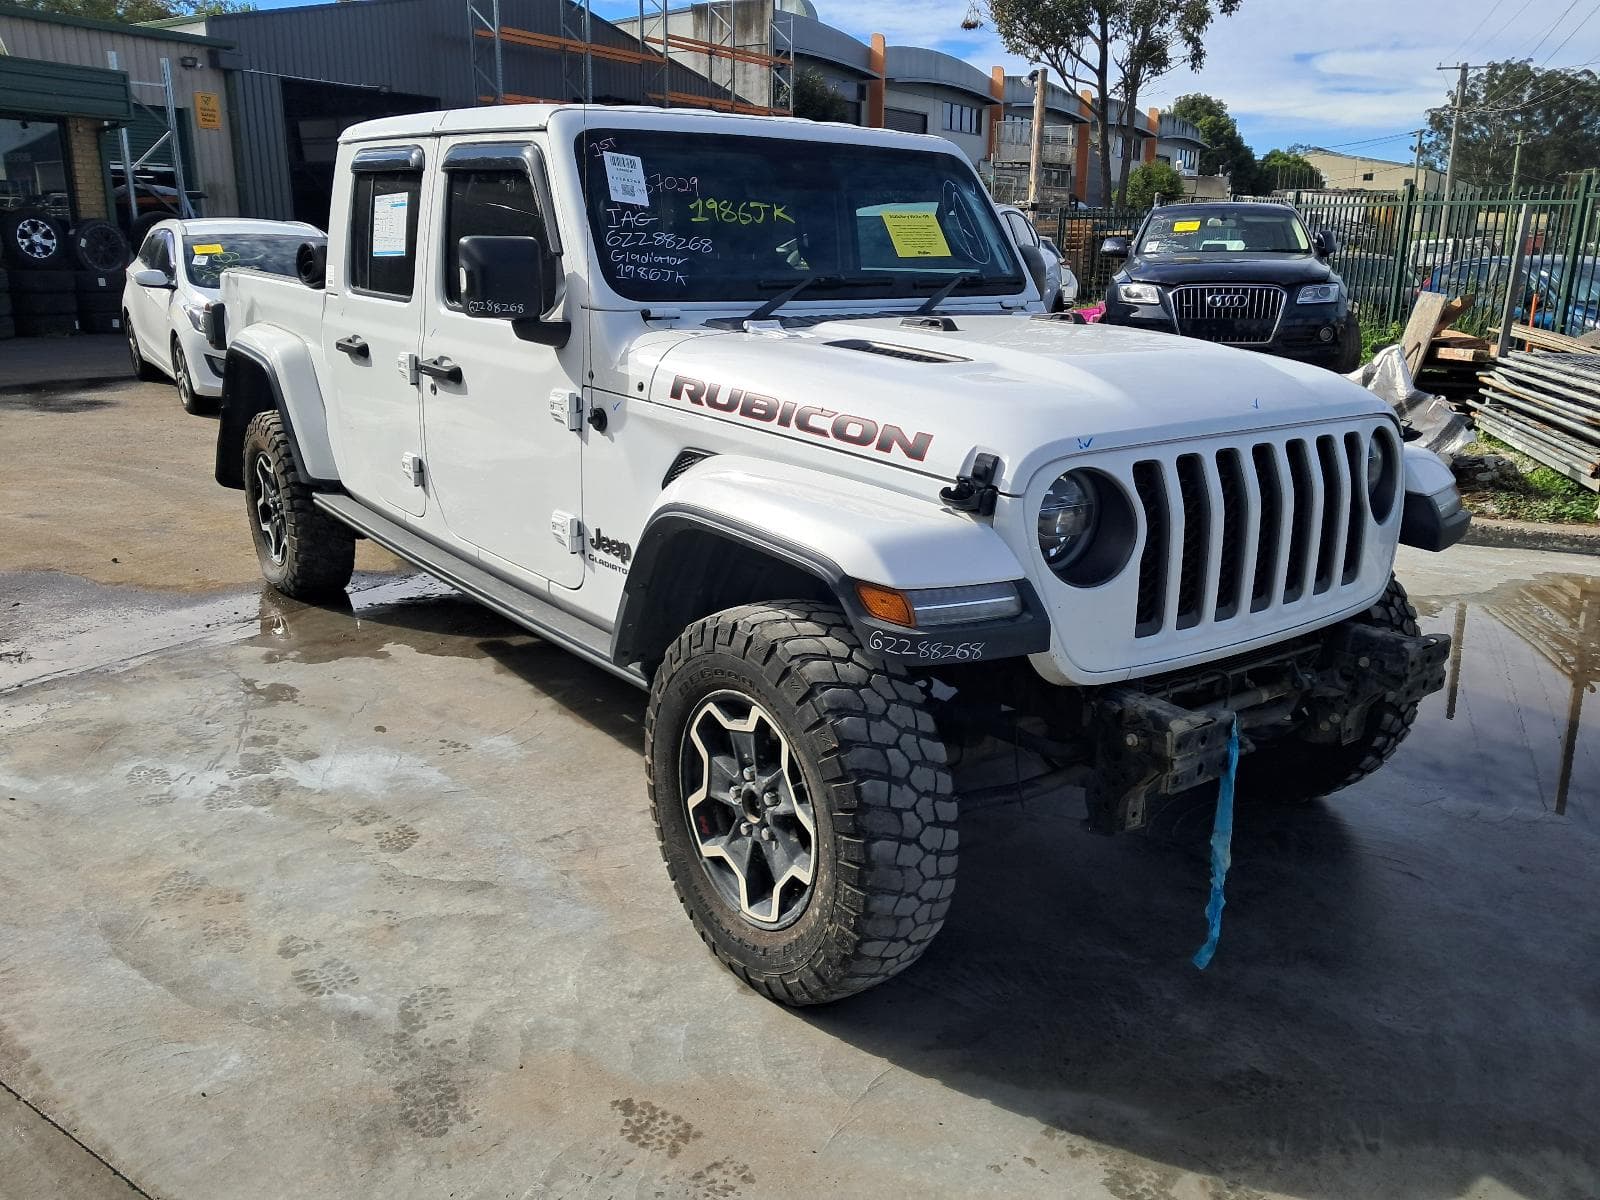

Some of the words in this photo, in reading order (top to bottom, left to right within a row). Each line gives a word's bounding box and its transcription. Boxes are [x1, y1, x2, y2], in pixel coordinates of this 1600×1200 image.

[590, 138, 616, 157] 1ST
[645, 174, 699, 197] 7029
[606, 208, 659, 228] IAG
[688, 197, 796, 225] 1986JK
[606, 230, 713, 253] 62288268
[616, 264, 688, 287] 1986JK
[468, 299, 525, 314] 62288268
[669, 374, 935, 462] RUBICON
[589, 527, 632, 565] Jeep
[588, 553, 629, 575] GLADIATO
[869, 630, 986, 660] 62288268
